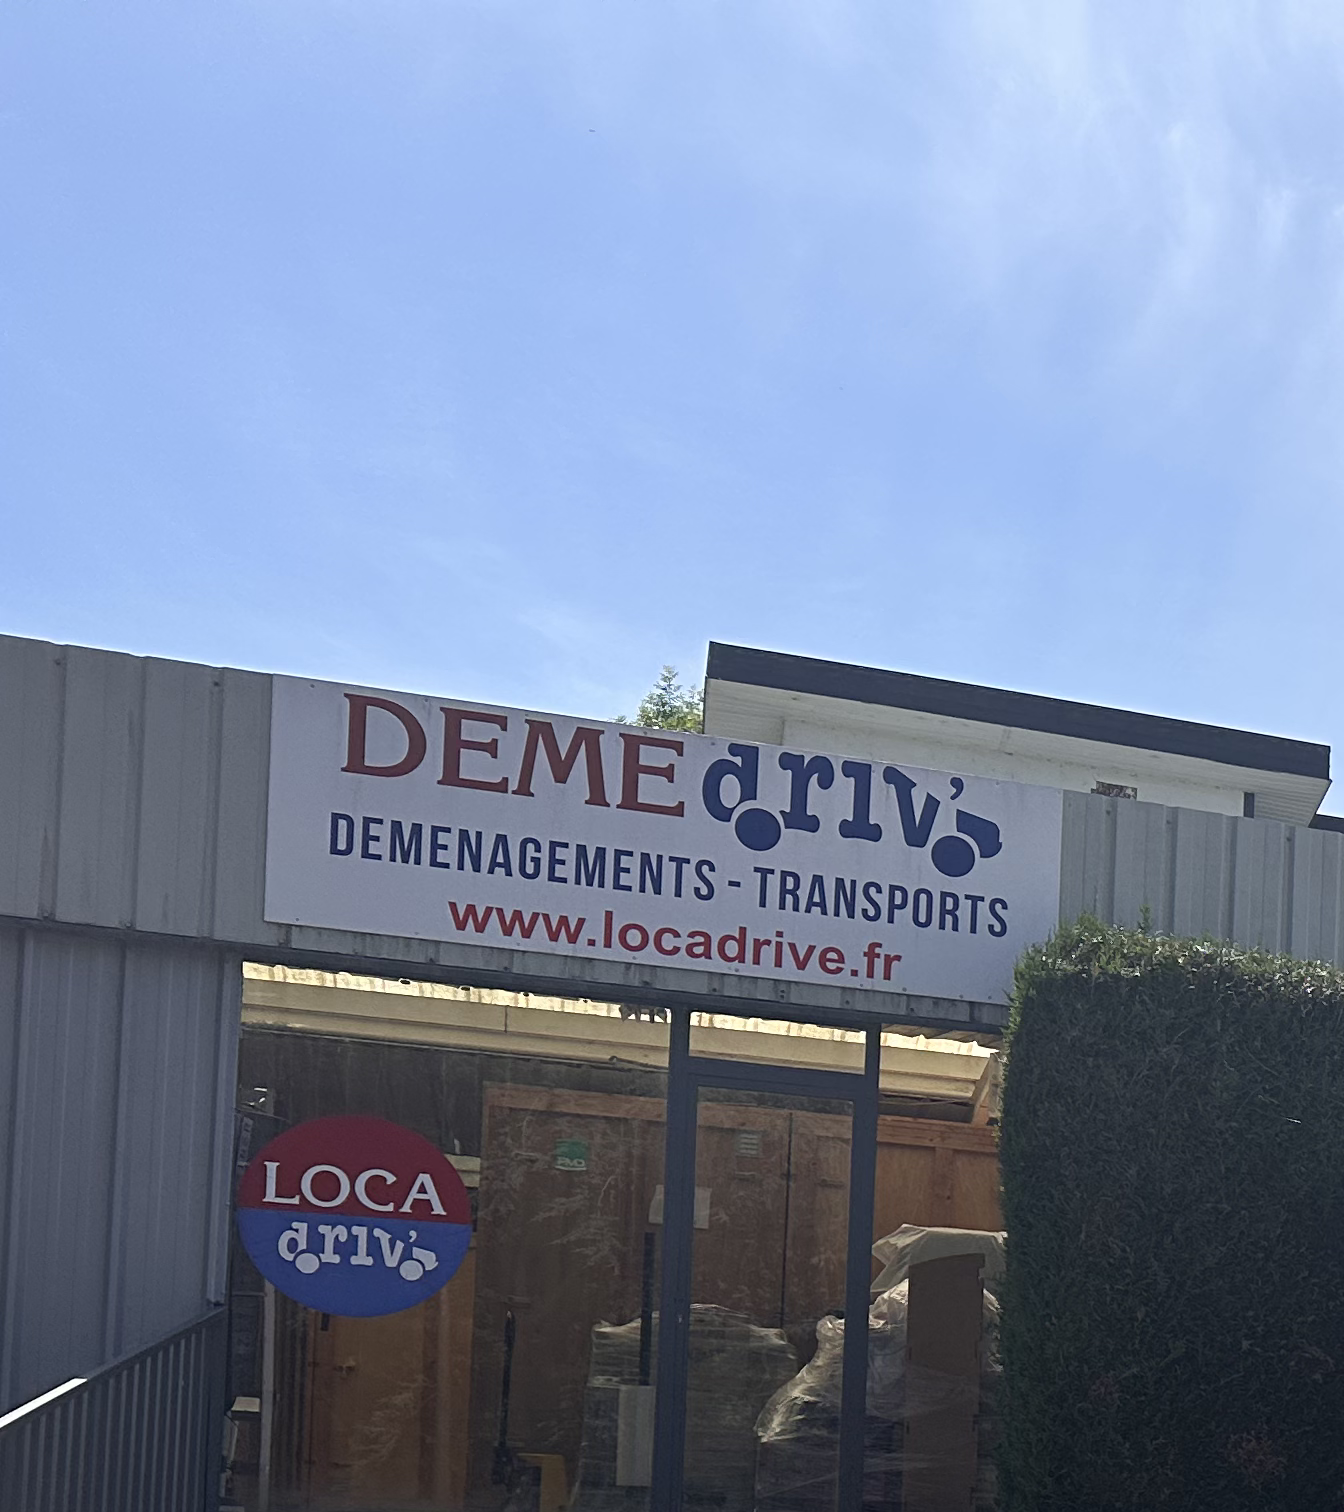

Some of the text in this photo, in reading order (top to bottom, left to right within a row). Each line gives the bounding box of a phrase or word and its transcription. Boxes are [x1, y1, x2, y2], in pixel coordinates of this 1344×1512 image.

[330, 811, 716, 903] DEMENAGEMENTS
[753, 866, 1009, 939] TRANSPORTS
[449, 901, 903, 982] www.locadrive.fr
[262, 1161, 447, 1216] LOCA
